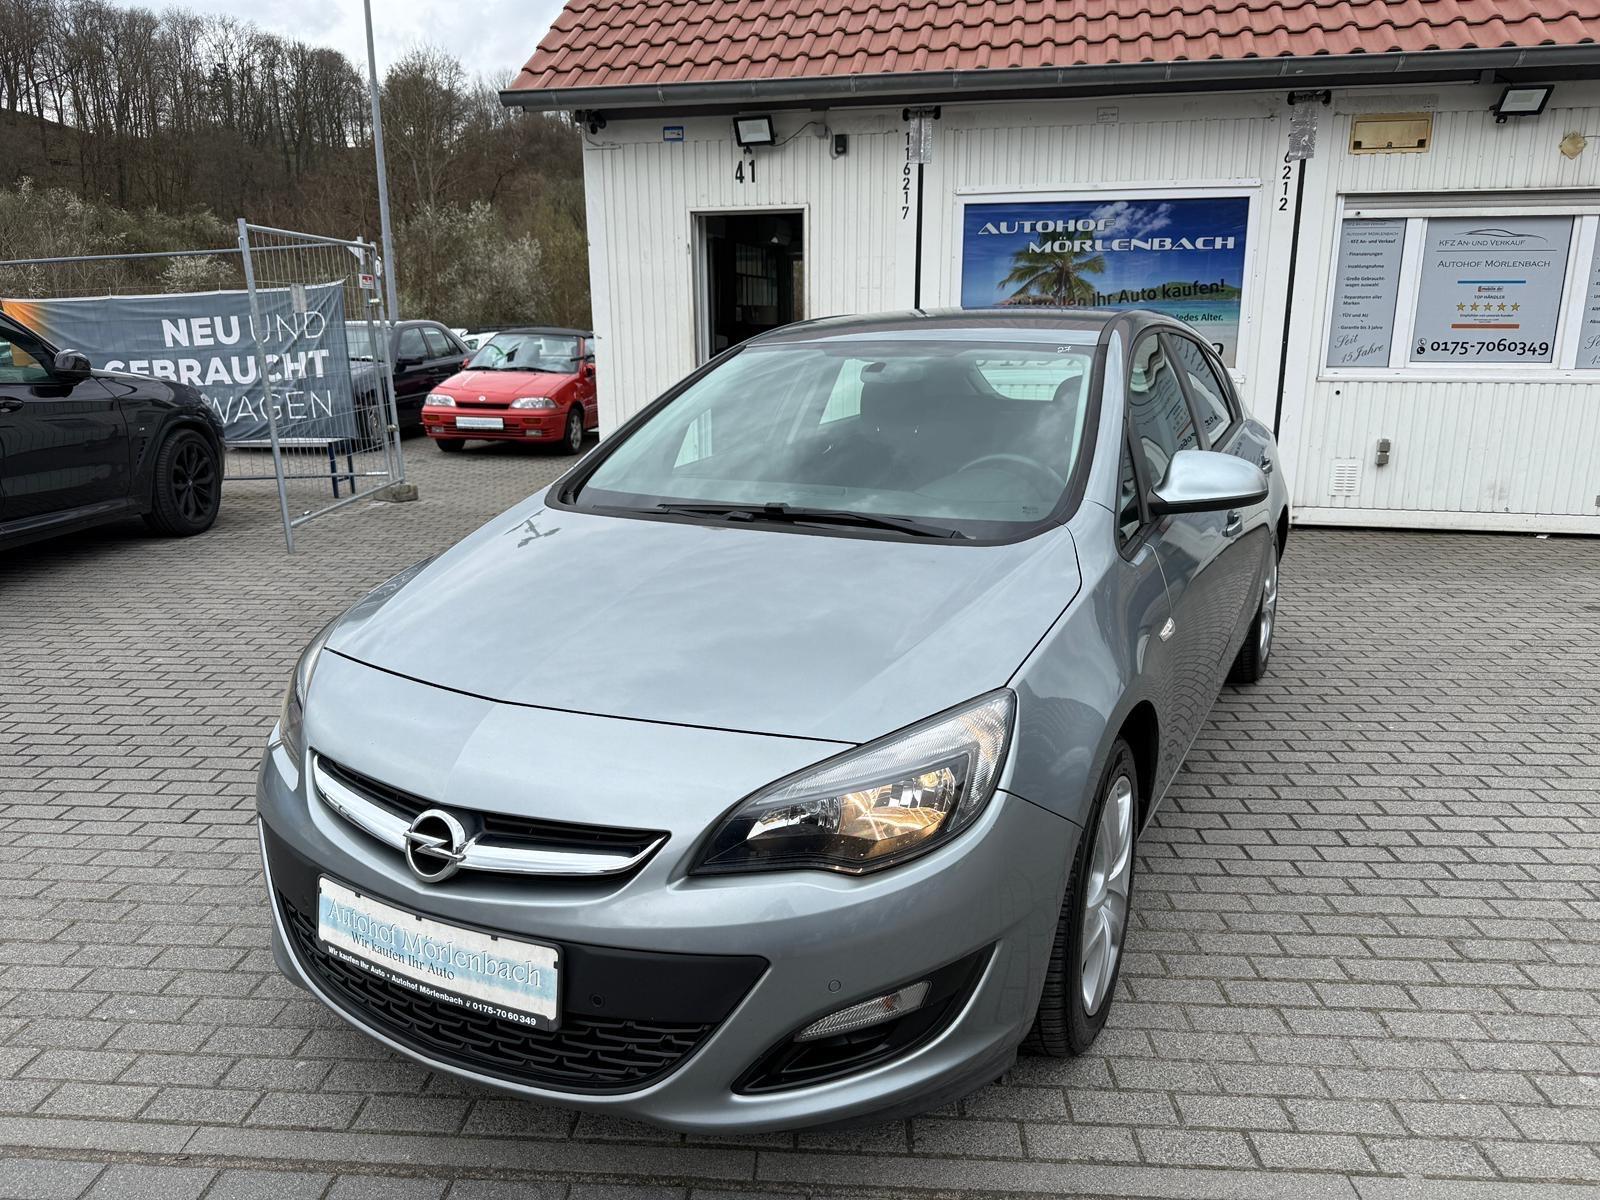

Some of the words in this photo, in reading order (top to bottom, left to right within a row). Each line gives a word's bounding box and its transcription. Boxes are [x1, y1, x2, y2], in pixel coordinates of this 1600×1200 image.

[735, 160, 755, 183] 41
[977, 218, 1116, 235] AUTOHOF
[1029, 237, 1235, 254] MÖRLENBACH
[1437, 260, 1482, 268] AUTOHOF
[1092, 291, 1112, 306] Ihr
[1118, 287, 1157, 303] Auto
[1162, 279, 1225, 299] kaufen!
[1201, 313, 1223, 321] Alter.
[161, 315, 241, 348] NEU
[248, 311, 326, 342] UND
[1430, 338, 1549, 356] 0175-7060349
[328, 898, 397, 946] Autohof
[402, 928, 542, 988] Mörlenbach
[351, 931, 369, 949] Wir
[370, 939, 405, 964] kaufen
[408, 954, 424, 970] Ihr
[427, 961, 455, 980] Auto
[328, 945, 338, 955] Wir
[339, 950, 359, 966] kaufen
[360, 960, 369, 970] Ihr
[371, 965, 385, 977] Auto
[391, 974, 418, 991] Autohof
[419, 985, 463, 1005] Mörlenbach
